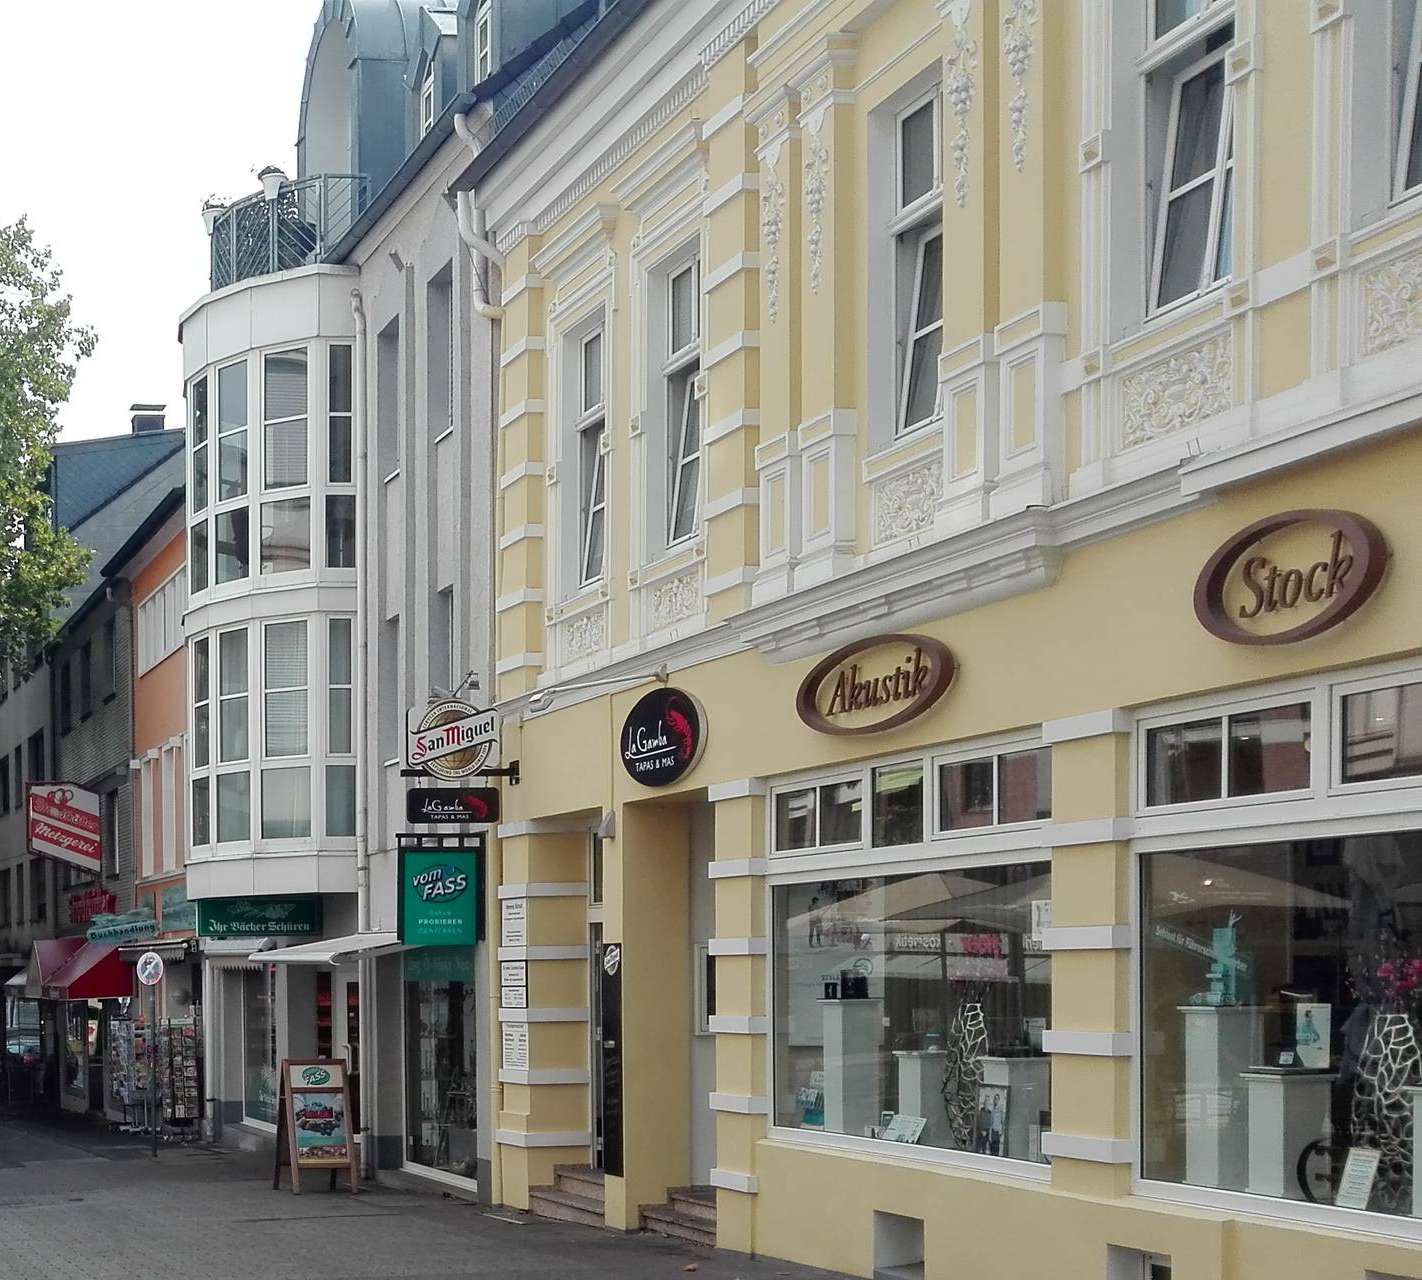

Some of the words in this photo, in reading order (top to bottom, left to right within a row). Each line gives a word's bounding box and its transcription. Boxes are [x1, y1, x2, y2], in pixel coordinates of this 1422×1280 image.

[1239, 529, 1354, 618] Stock
[825, 647, 928, 717] Akustik
[443, 716, 495, 746] Miguel
[637, 720, 668, 752] Gamba
[635, 760, 654, 773] TAPAS
[655, 760, 660, 769] &
[661, 756, 675, 767] MAS
[35, 822, 98, 853] Metzgerei
[413, 869, 442, 887] vom
[423, 874, 467, 900] FASS
[90, 923, 156, 940] Buchhandlung
[209, 919, 228, 933] Ihr
[230, 921, 266, 932] Bäcker
[268, 921, 310, 932] Schüren
[305, 1070, 326, 1086] FASS
